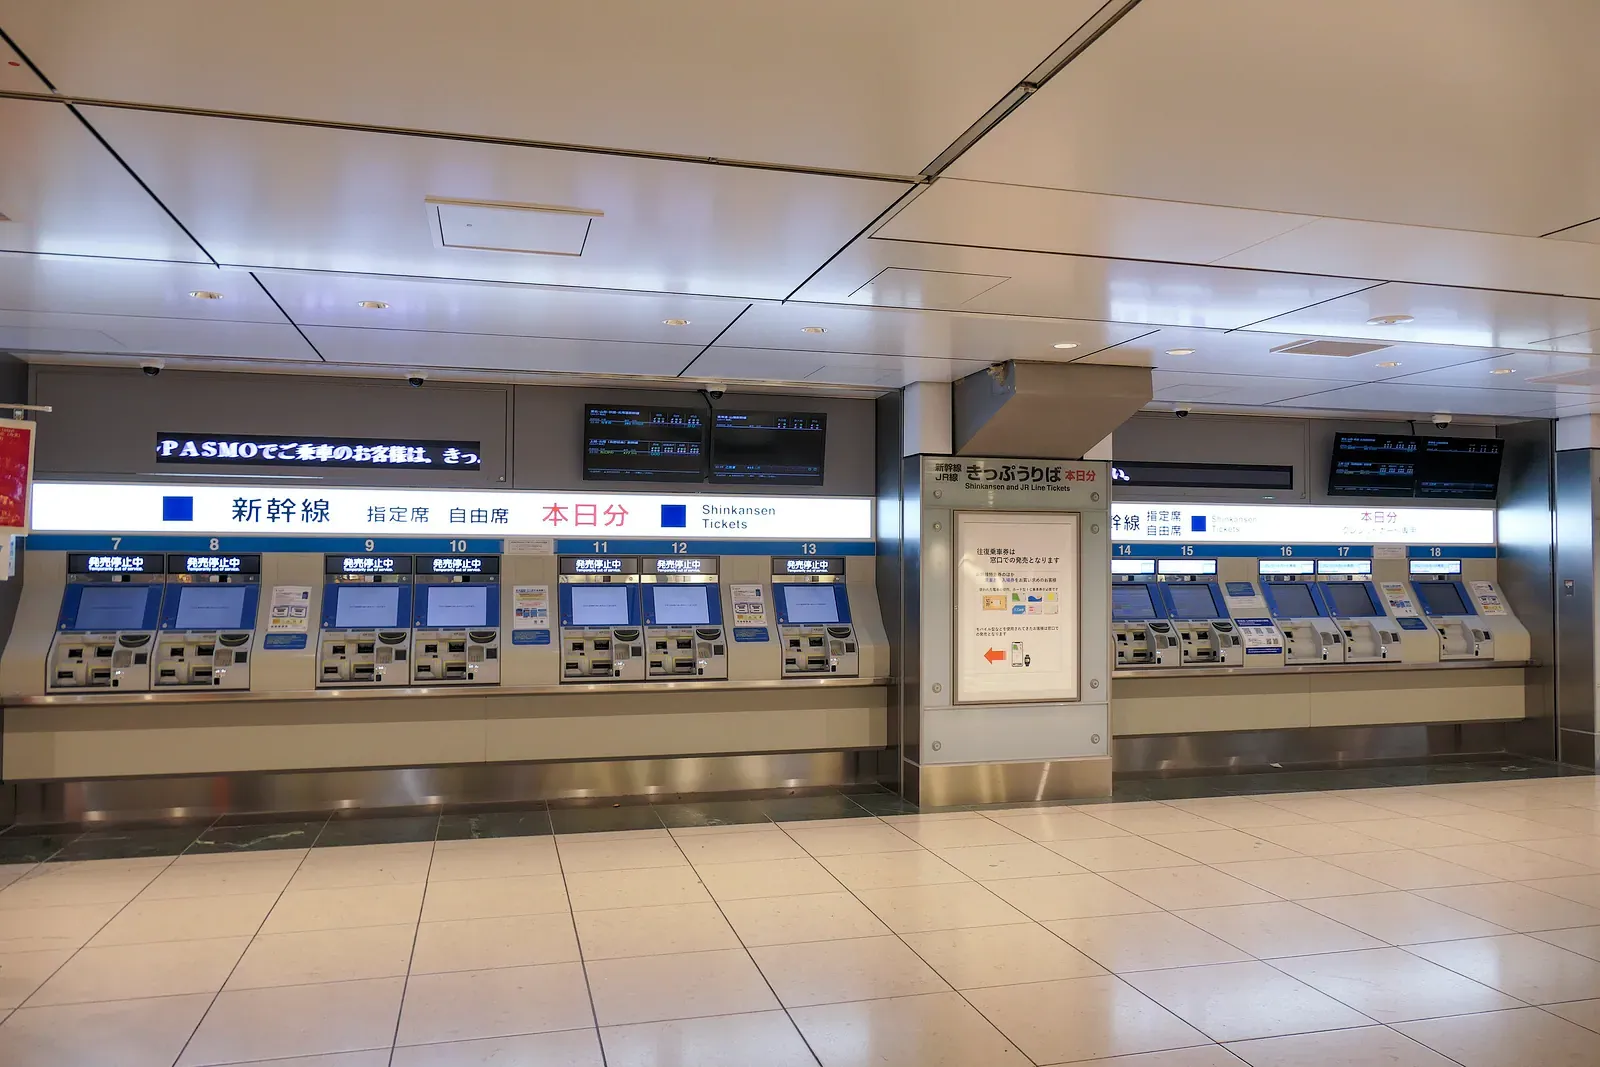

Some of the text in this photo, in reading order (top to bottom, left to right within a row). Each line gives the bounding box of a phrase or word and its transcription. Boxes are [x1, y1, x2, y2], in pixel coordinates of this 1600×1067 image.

[156, 440, 480, 465] PASMOでご乗車のお客様は、きっ
[935, 464, 962, 472] 新幹線
[935, 473, 959, 482] JR線
[966, 466, 1062, 482] きっぷうりば
[1065, 470, 1096, 482] 本日分
[965, 482, 1004, 490] Shinkansen
[232, 498, 629, 527] 新幹線 指定席 自由席 本日分
[702, 504, 776, 516] Shinkansen
[1147, 511, 1181, 522] 指定席
[1361, 511, 1397, 523] 本日分
[702, 519, 748, 529] Tickets
[1147, 525, 1181, 536] 自由席
[112, 537, 122, 550] 7
[209, 538, 219, 551] 8
[365, 539, 374, 552] 9
[450, 540, 467, 552] 10
[593, 542, 608, 553] 11
[672, 542, 687, 554] 12
[802, 543, 817, 555] 13
[1118, 545, 1132, 556] 14
[1181, 546, 1194, 556] 15
[1280, 547, 1292, 556] 16
[1338, 547, 1349, 557] 17
[1430, 548, 1441, 557] 18
[89, 556, 144, 568] 発売停止中
[187, 556, 240, 568] 発売停止中
[343, 557, 394, 568] 発売停止中
[433, 557, 482, 569] 発売停止中
[576, 559, 621, 569] 発売停止中
[657, 559, 701, 569] 発売停止中
[787, 560, 828, 570] 発売停止中
